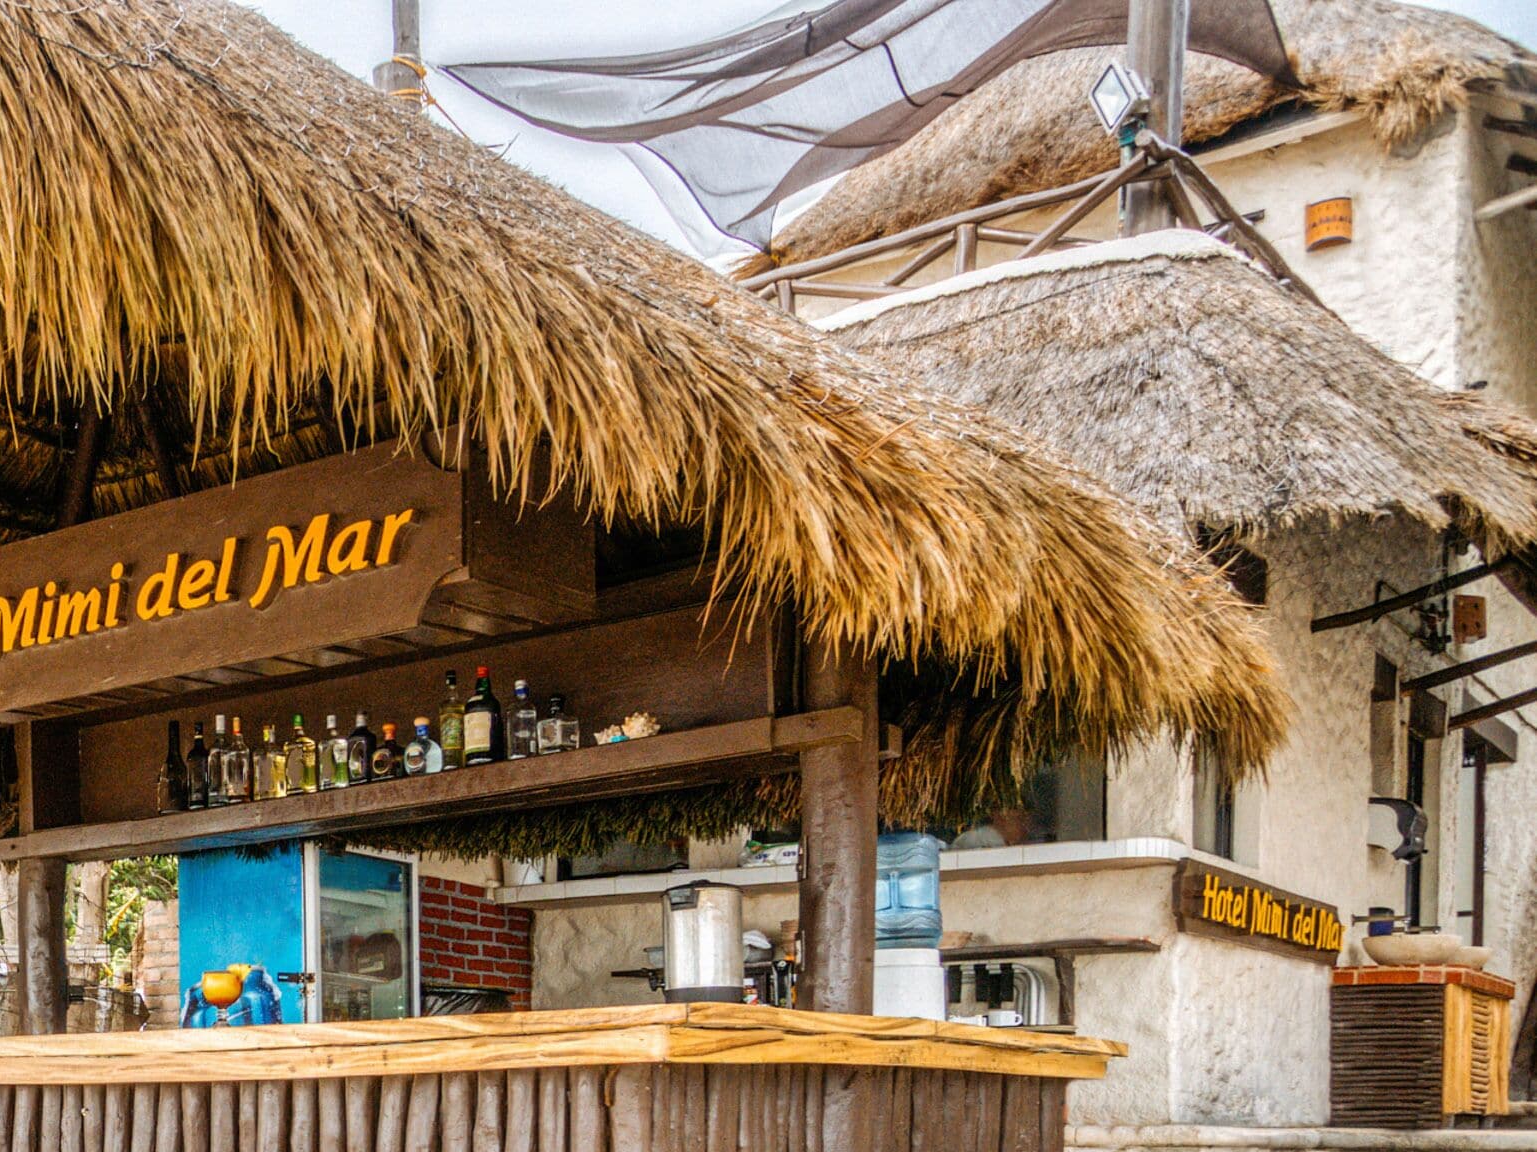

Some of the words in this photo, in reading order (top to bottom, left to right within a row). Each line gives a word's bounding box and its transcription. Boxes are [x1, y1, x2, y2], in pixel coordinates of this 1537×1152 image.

[136, 536, 236, 622] del
[248, 508, 414, 609] Mar
[1202, 873, 1249, 929] Hotel
[1250, 888, 1289, 938] Mimi
[1292, 904, 1316, 946] del
[1316, 908, 1347, 952] Mar
